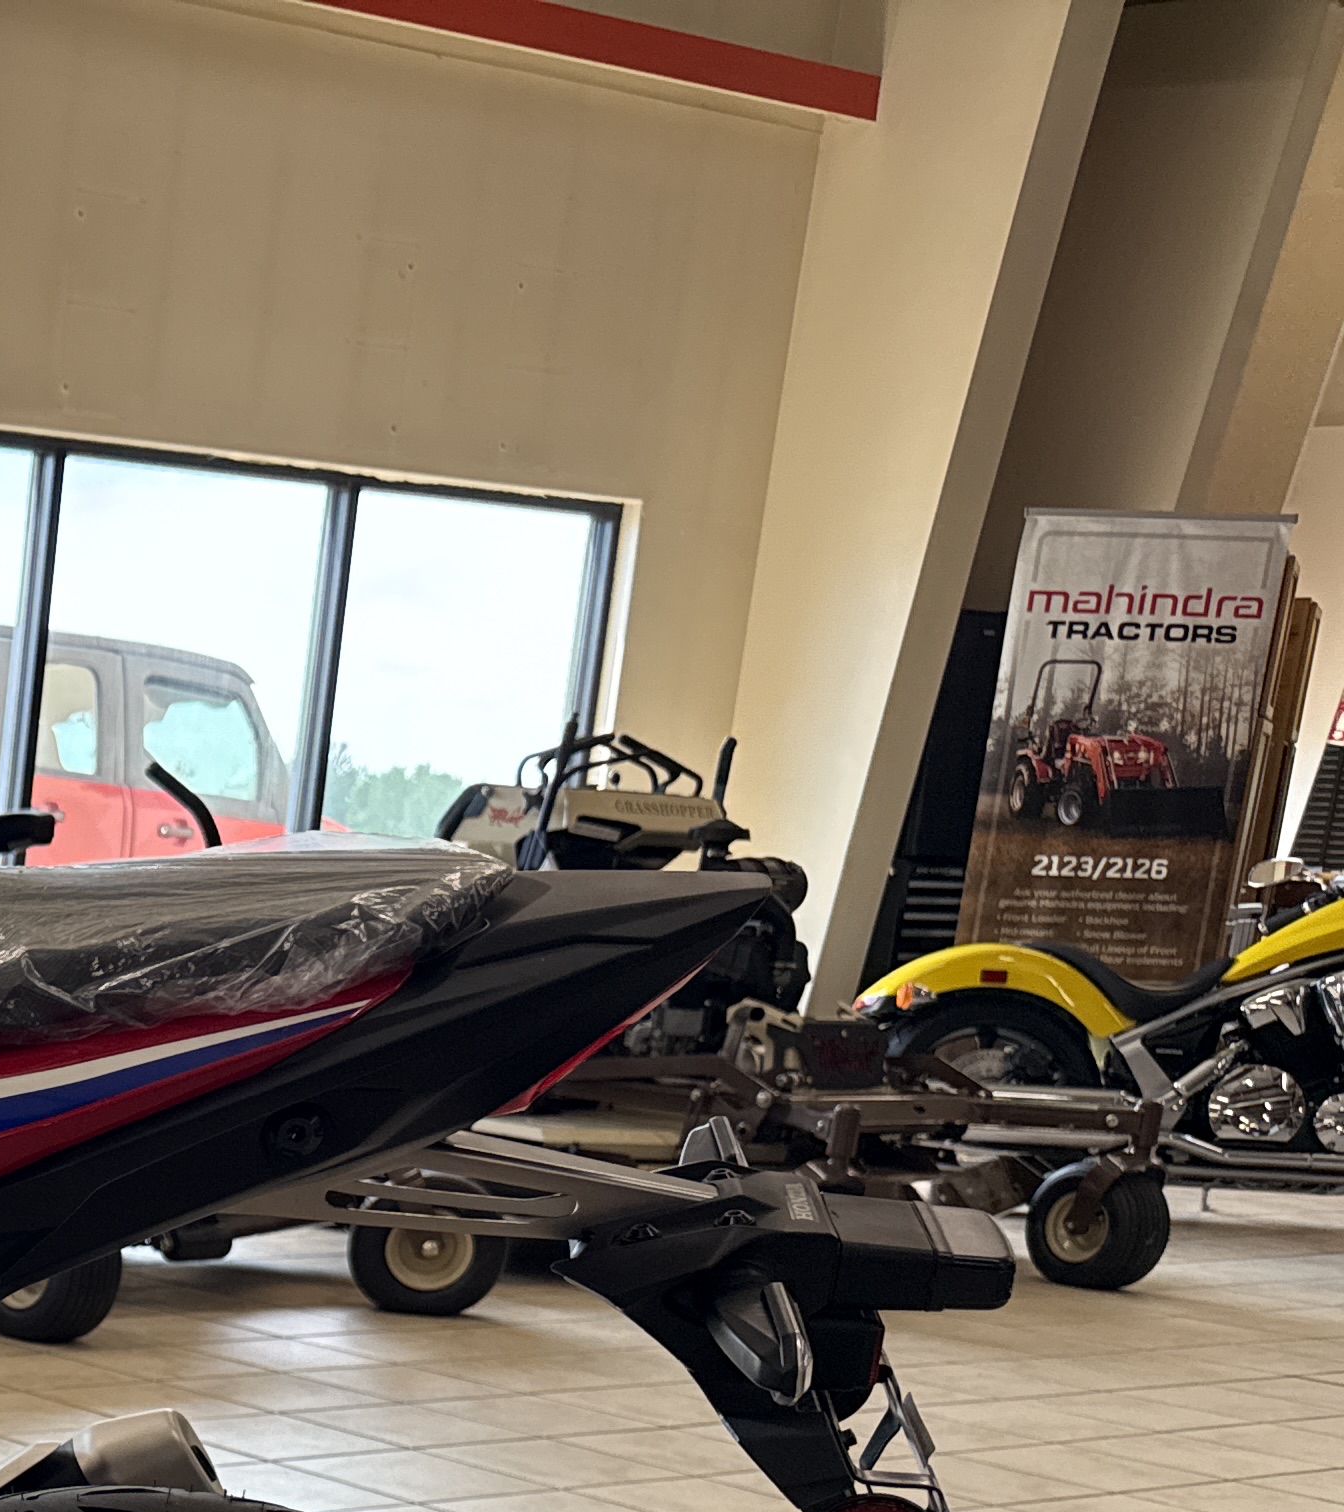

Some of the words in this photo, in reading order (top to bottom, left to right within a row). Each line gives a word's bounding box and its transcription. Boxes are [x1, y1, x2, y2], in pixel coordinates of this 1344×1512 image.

[1026, 584, 1264, 619] mahindra
[1047, 620, 1238, 644] TRACTORS
[614, 799, 714, 819] GRASSHOPPER
[1030, 854, 1169, 881] 2123/2126
